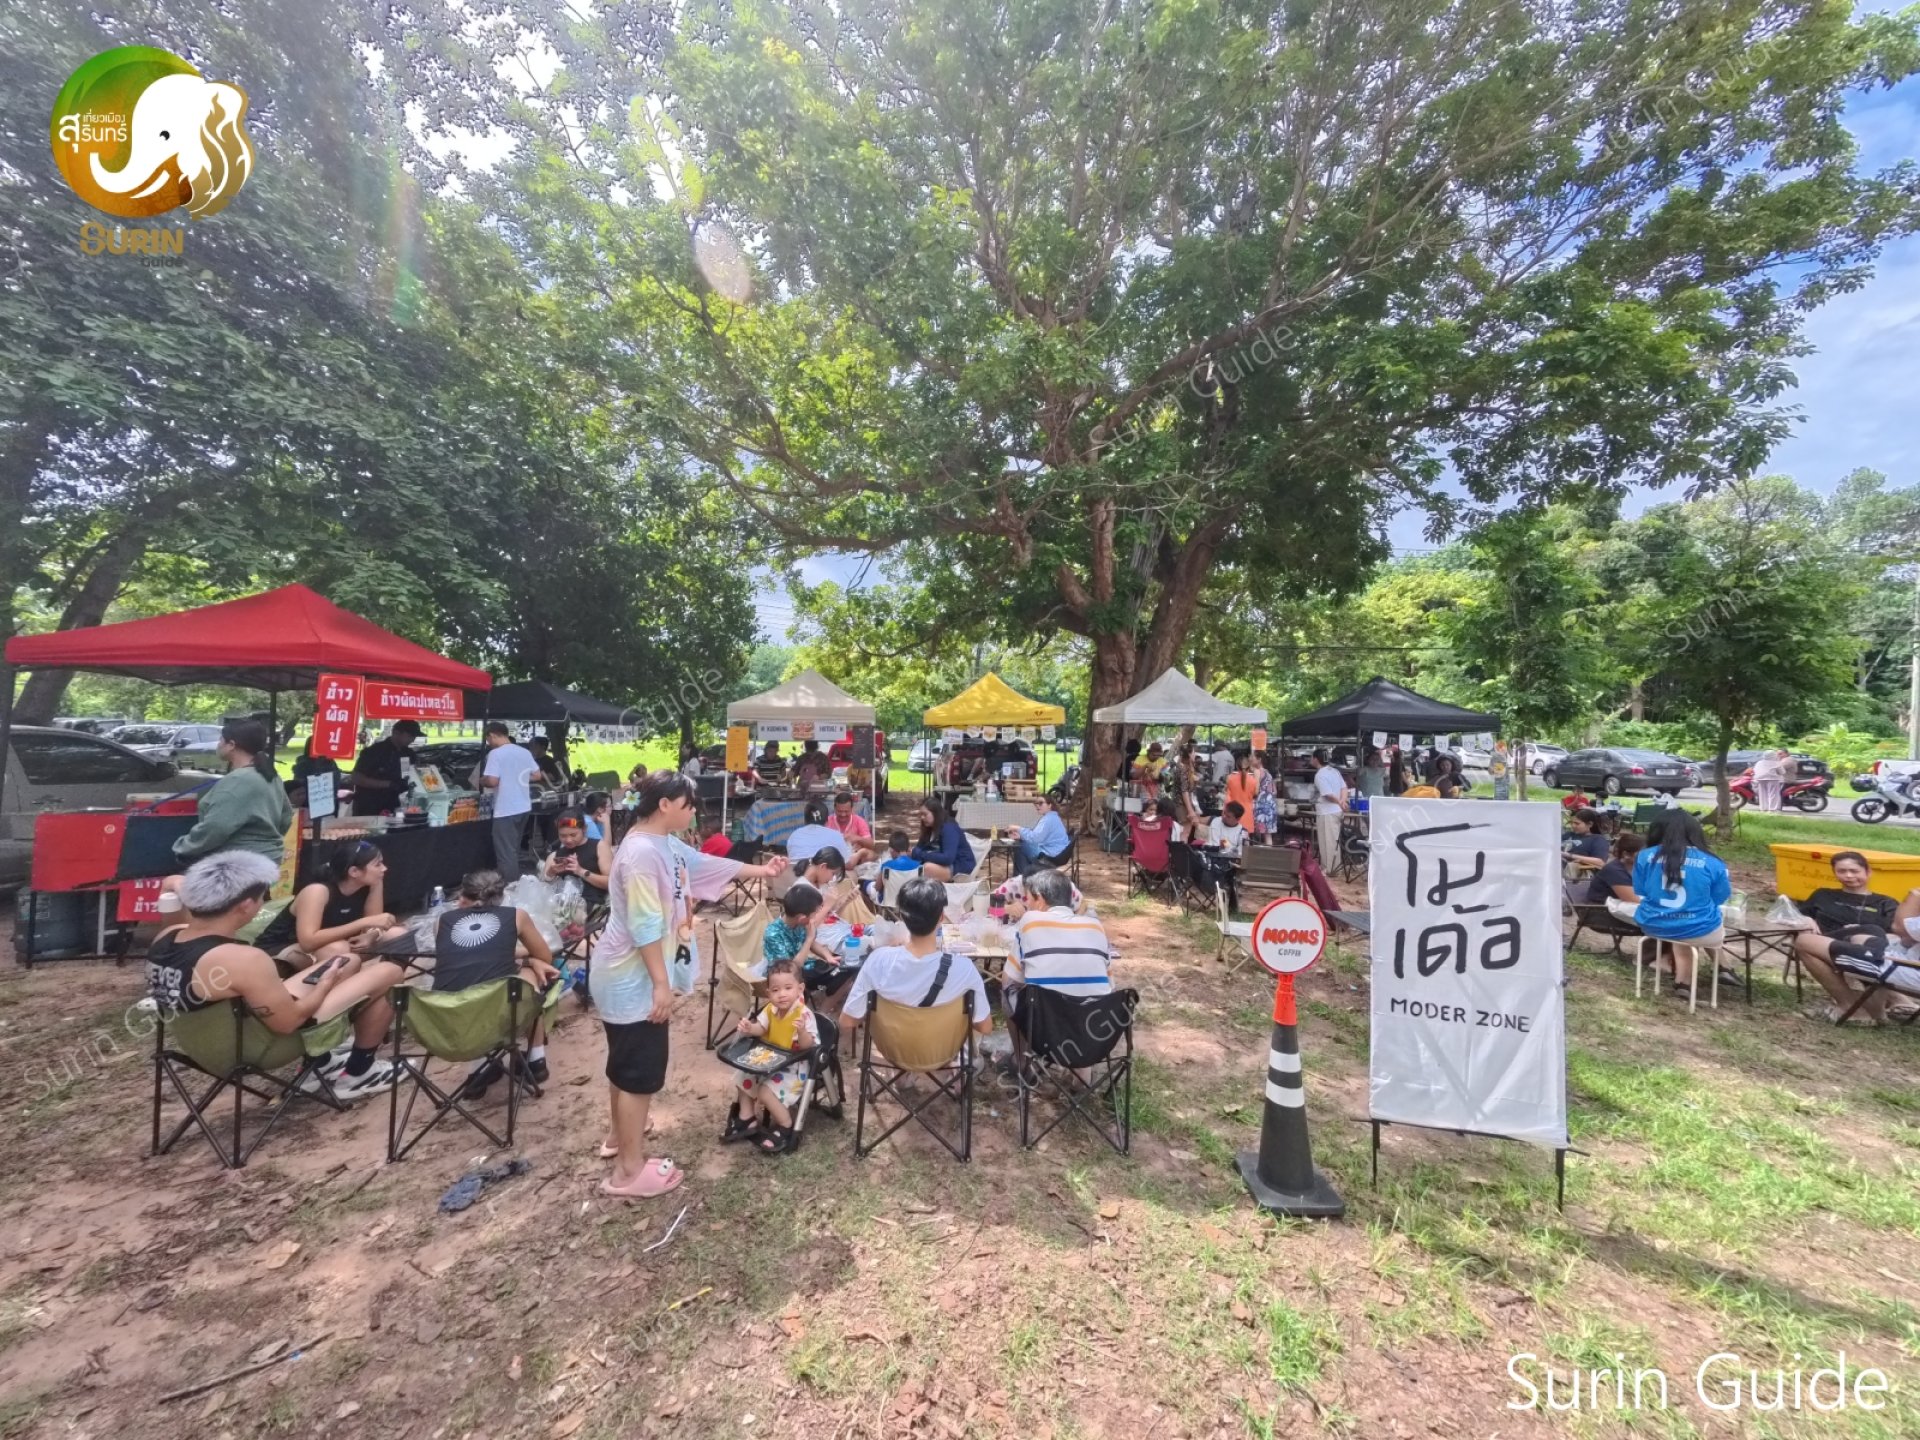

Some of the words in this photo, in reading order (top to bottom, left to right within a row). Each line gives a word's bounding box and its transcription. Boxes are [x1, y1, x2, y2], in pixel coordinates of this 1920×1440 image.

[326, 682, 353, 700] ข้าว
[326, 704, 349, 722] ผัด
[328, 727, 342, 751] ปู
[1660, 868, 1687, 910] 5
[1262, 927, 1319, 946] MOONS
[1391, 997, 1466, 1024] MODER
[1476, 1010, 1531, 1033] ZONE
